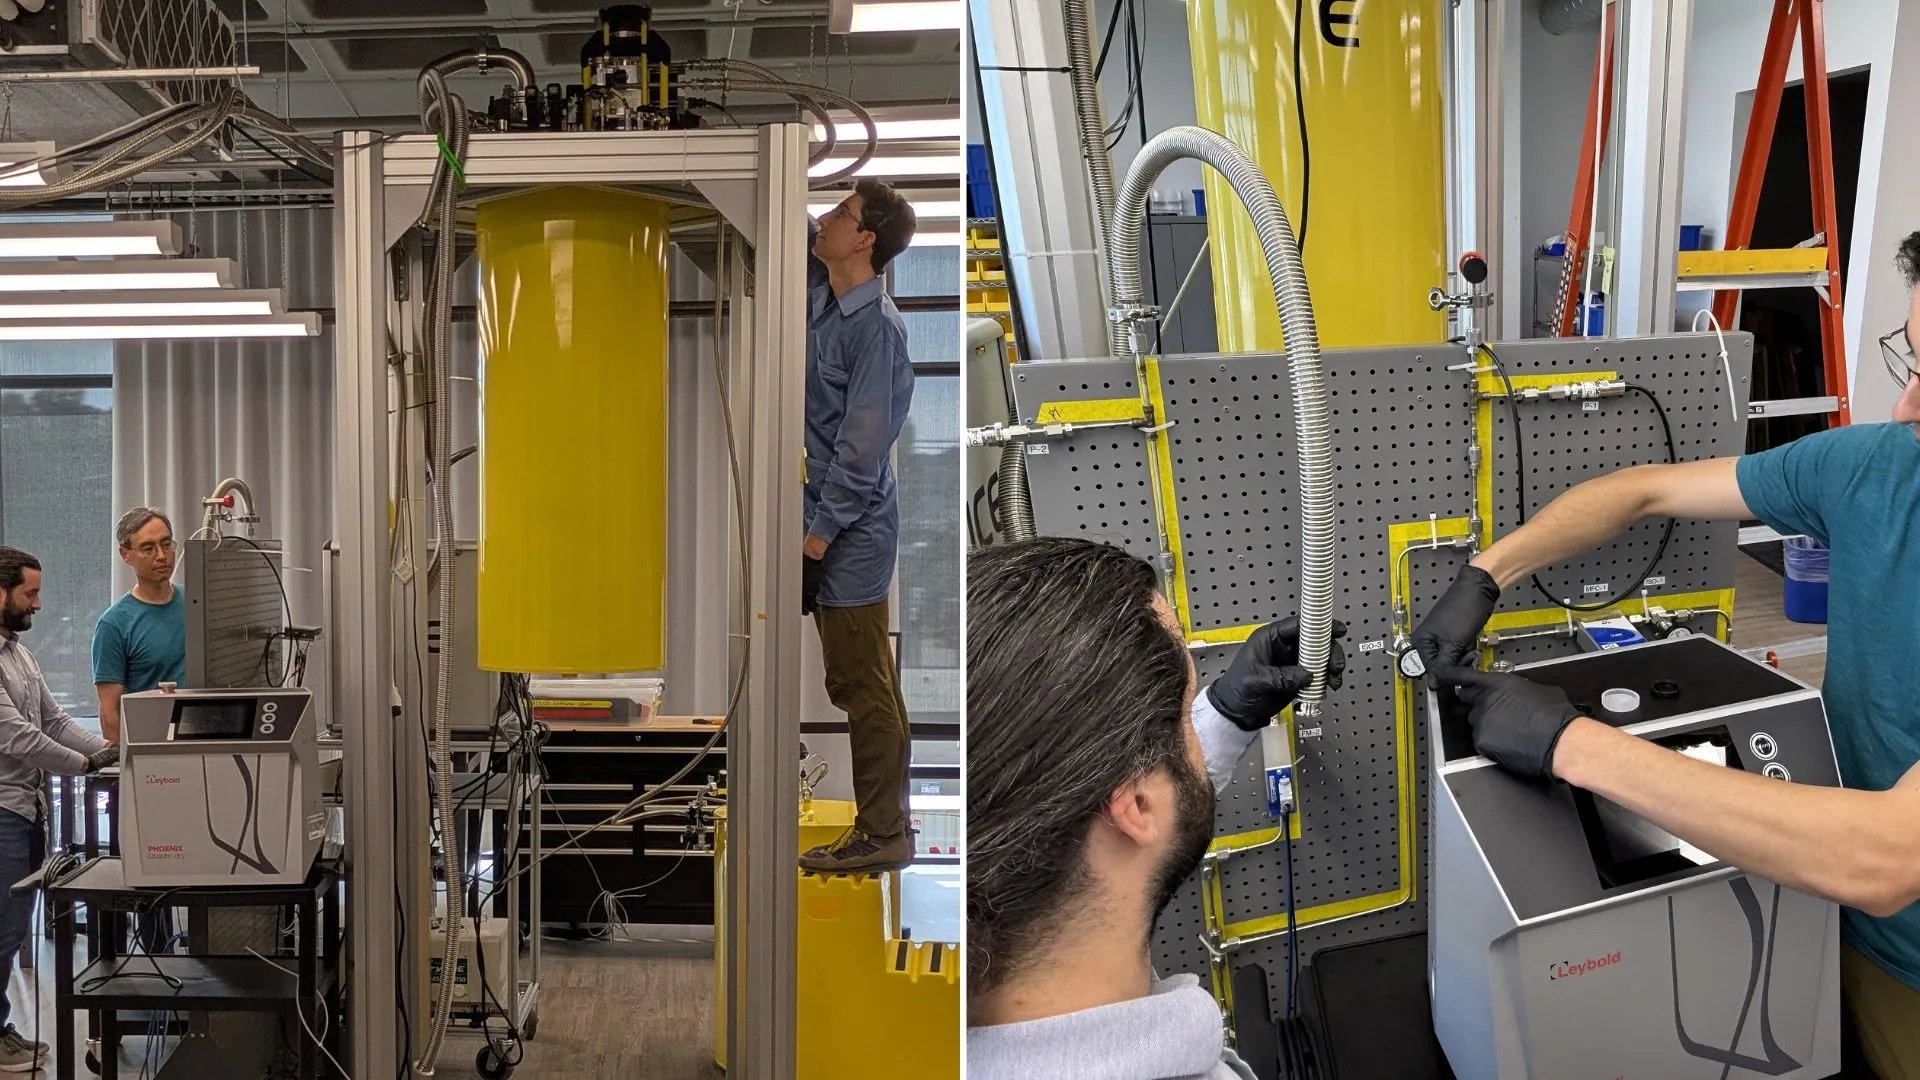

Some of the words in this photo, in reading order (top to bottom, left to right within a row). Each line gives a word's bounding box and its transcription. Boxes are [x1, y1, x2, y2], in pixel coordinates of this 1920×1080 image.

[1030, 445, 1047, 453] P-2
[1645, 577, 1664, 585] ISO-1
[1361, 641, 1382, 650] ISO-3
[1301, 728, 1321, 737] FM-2
[149, 776, 181, 785] Leybold
[1556, 950, 1622, 978] Leybold
